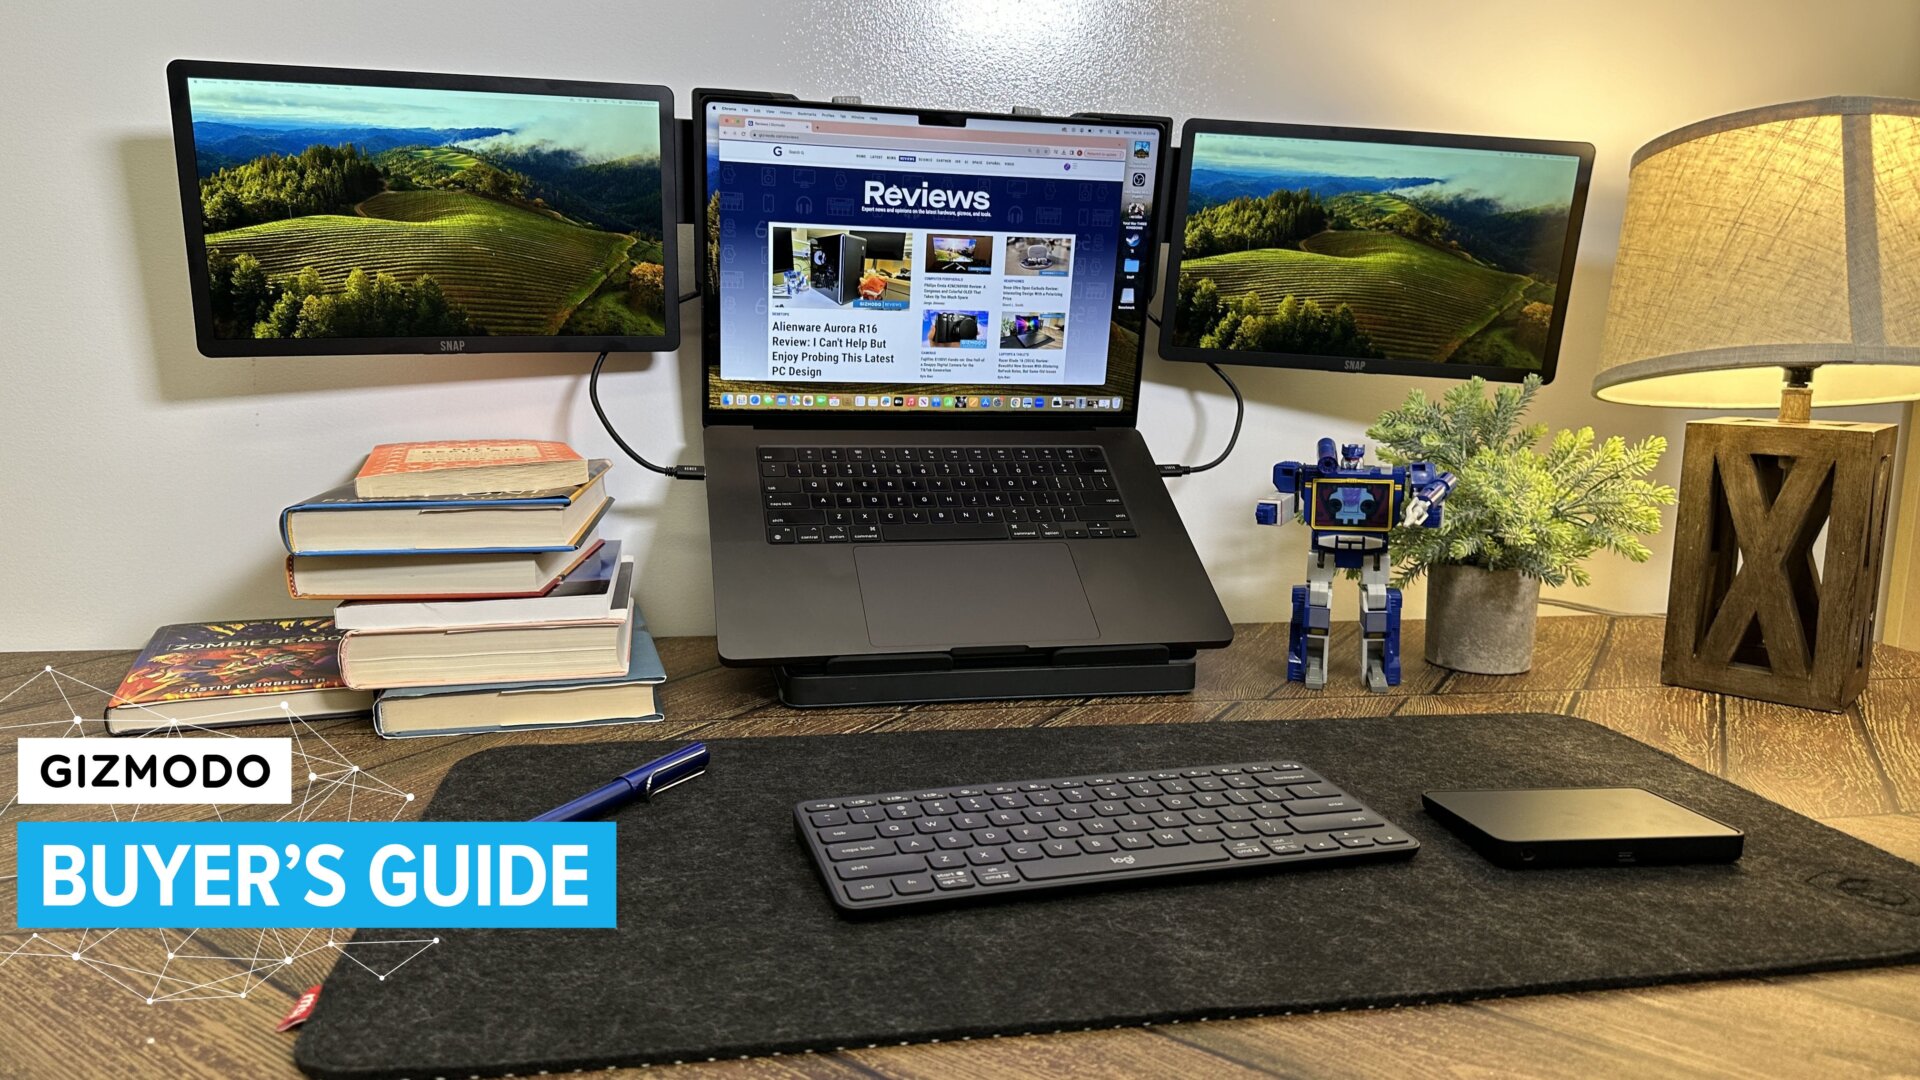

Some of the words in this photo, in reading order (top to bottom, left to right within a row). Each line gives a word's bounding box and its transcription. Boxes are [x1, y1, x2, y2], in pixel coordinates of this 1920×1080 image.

[864, 180, 991, 210] Reviews
[895, 207, 912, 215] opinions
[772, 321, 821, 333] Alienware
[823, 323, 857, 333] Aurora
[859, 324, 878, 334] R16
[440, 340, 465, 352] SNAP
[772, 336, 811, 347] Review:
[813, 338, 816, 347] I
[819, 338, 843, 348] Can't
[845, 338, 868, 351] Help
[870, 339, 887, 349] But
[772, 351, 799, 364] Enjoy
[801, 352, 839, 365] Probing
[841, 353, 862, 363] This
[865, 353, 895, 364] Latest
[1343, 360, 1366, 371] SNAP
[772, 366, 786, 377] PC
[788, 367, 822, 379] Design
[171, 638, 260, 651] ZOMBIE
[268, 635, 342, 646] SEASO
[180, 684, 231, 694] JUSTIN
[236, 677, 326, 689] WEINBERGER
[1110, 855, 1136, 864] logi
